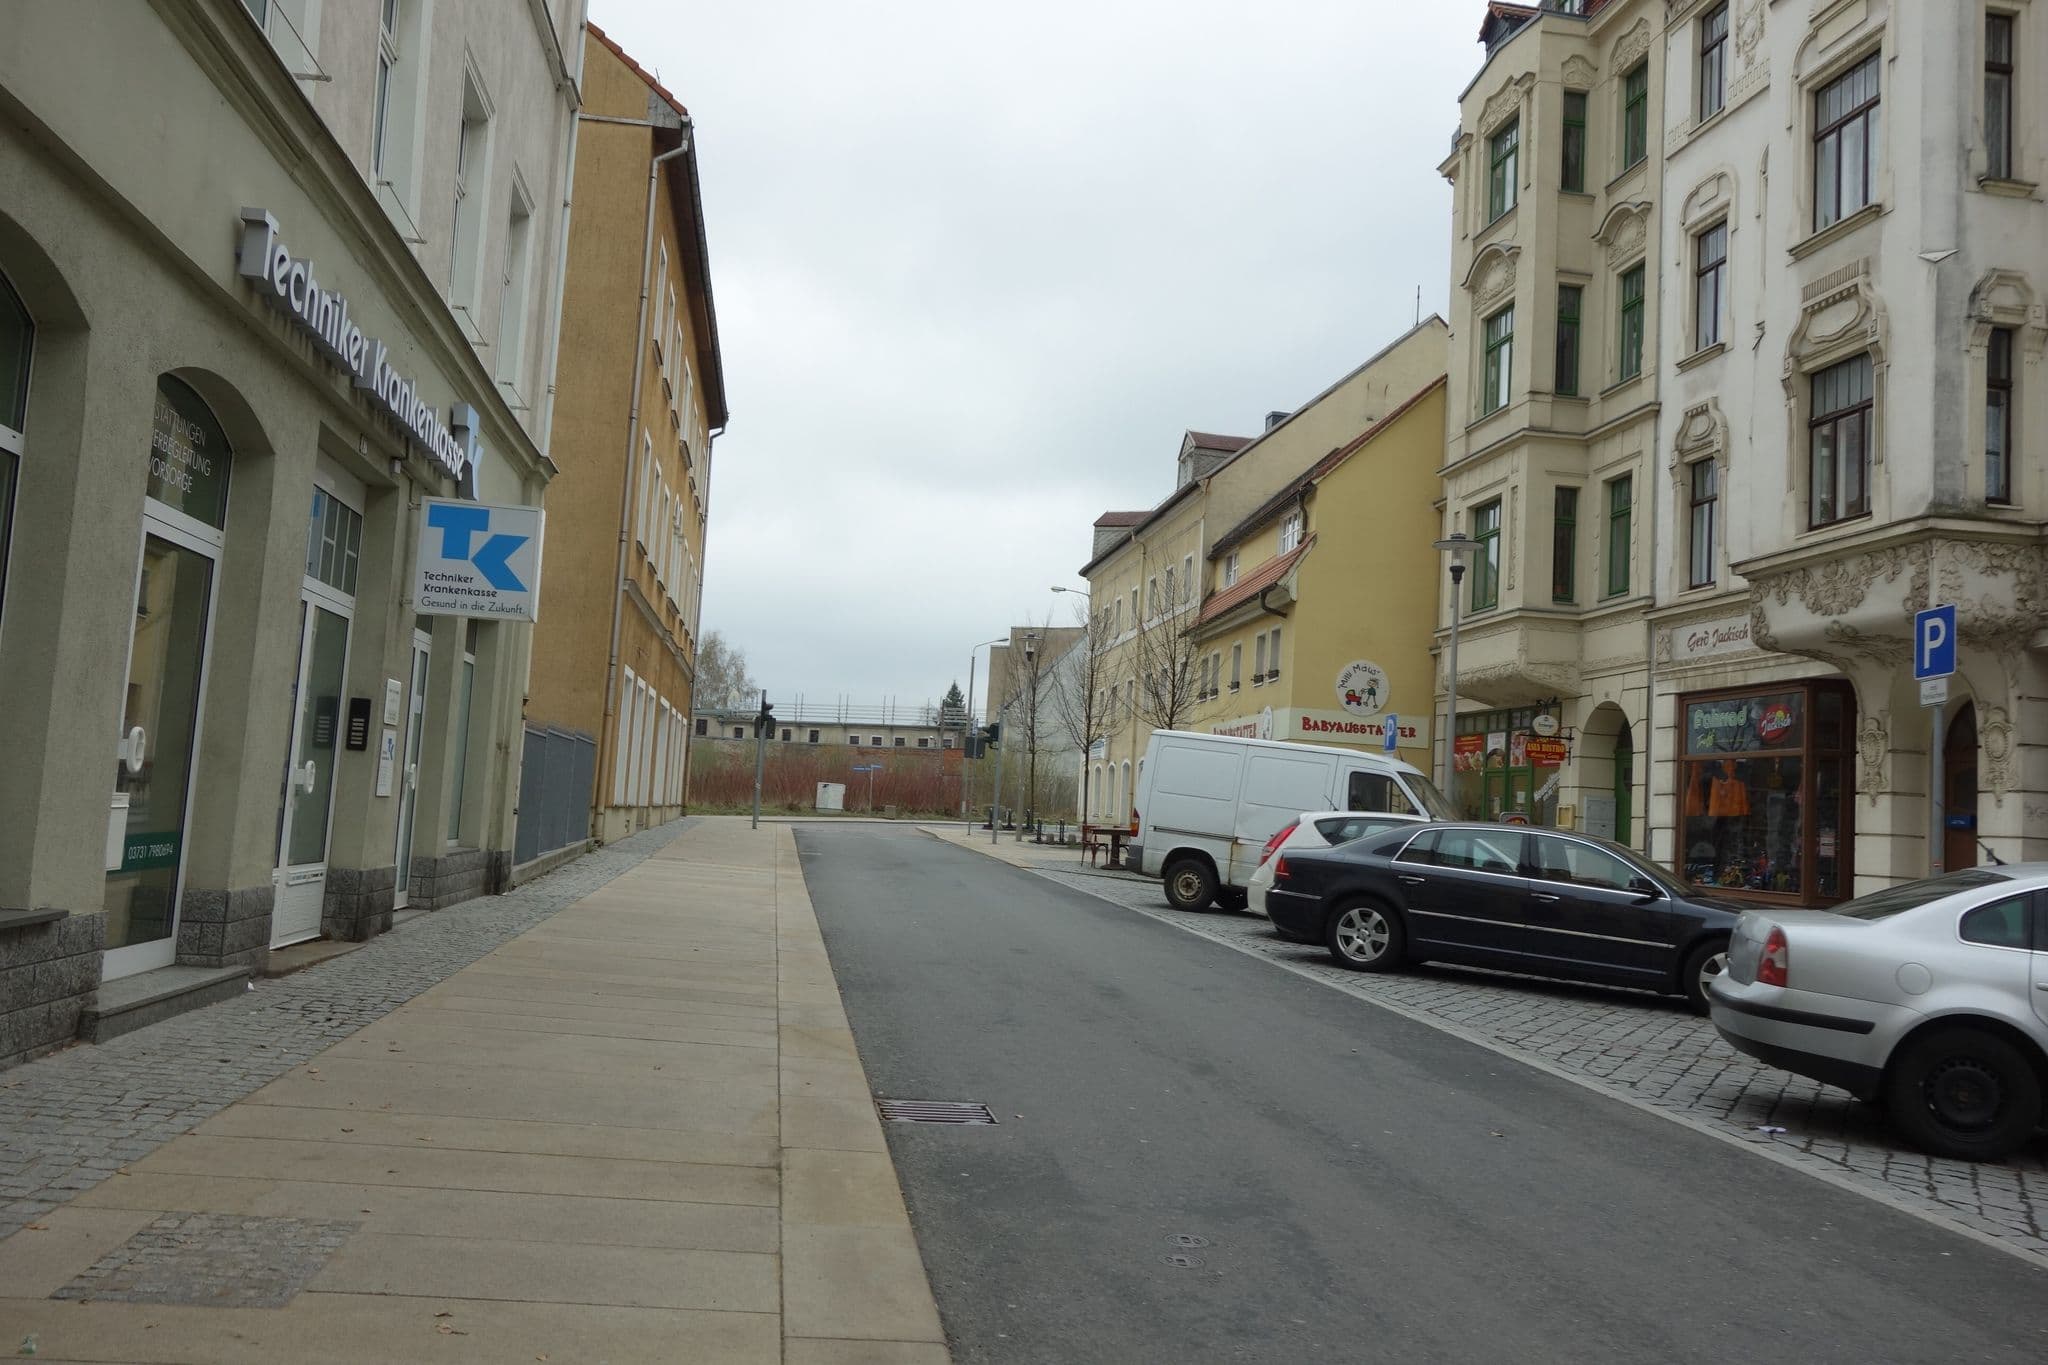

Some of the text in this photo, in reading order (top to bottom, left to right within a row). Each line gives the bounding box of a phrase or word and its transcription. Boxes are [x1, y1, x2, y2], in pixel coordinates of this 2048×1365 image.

[241, 206, 465, 481] Techniker Krankenkasse
[428, 504, 530, 592] TK
[423, 571, 474, 584] Techniker
[423, 583, 498, 598] Krankenkasse
[421, 596, 457, 609] Gesund
[459, 601, 468, 610] in
[471, 601, 486, 611] die
[1687, 622, 1749, 652] Gerd Jackisch
[1923, 617, 1946, 670] P
[1302, 716, 1417, 738] BABYAUSSTAER
[1386, 718, 1395, 747] P
